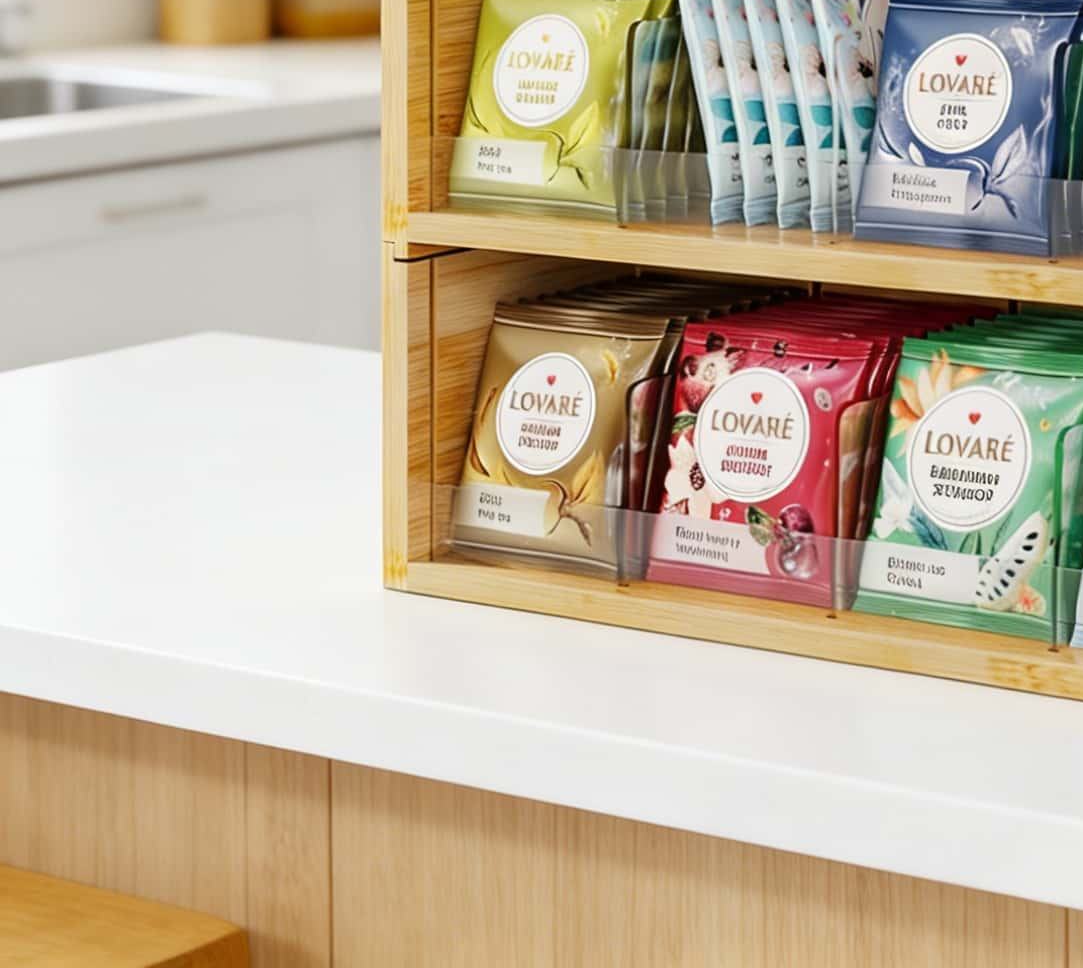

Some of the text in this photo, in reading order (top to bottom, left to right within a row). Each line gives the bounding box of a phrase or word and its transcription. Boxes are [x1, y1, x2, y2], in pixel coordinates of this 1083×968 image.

[919, 71, 998, 97] LOVARÉ
[509, 389, 584, 418] LOVARÉ
[711, 408, 796, 442] LOVARÉ
[924, 430, 1016, 463] LOVARÉ
